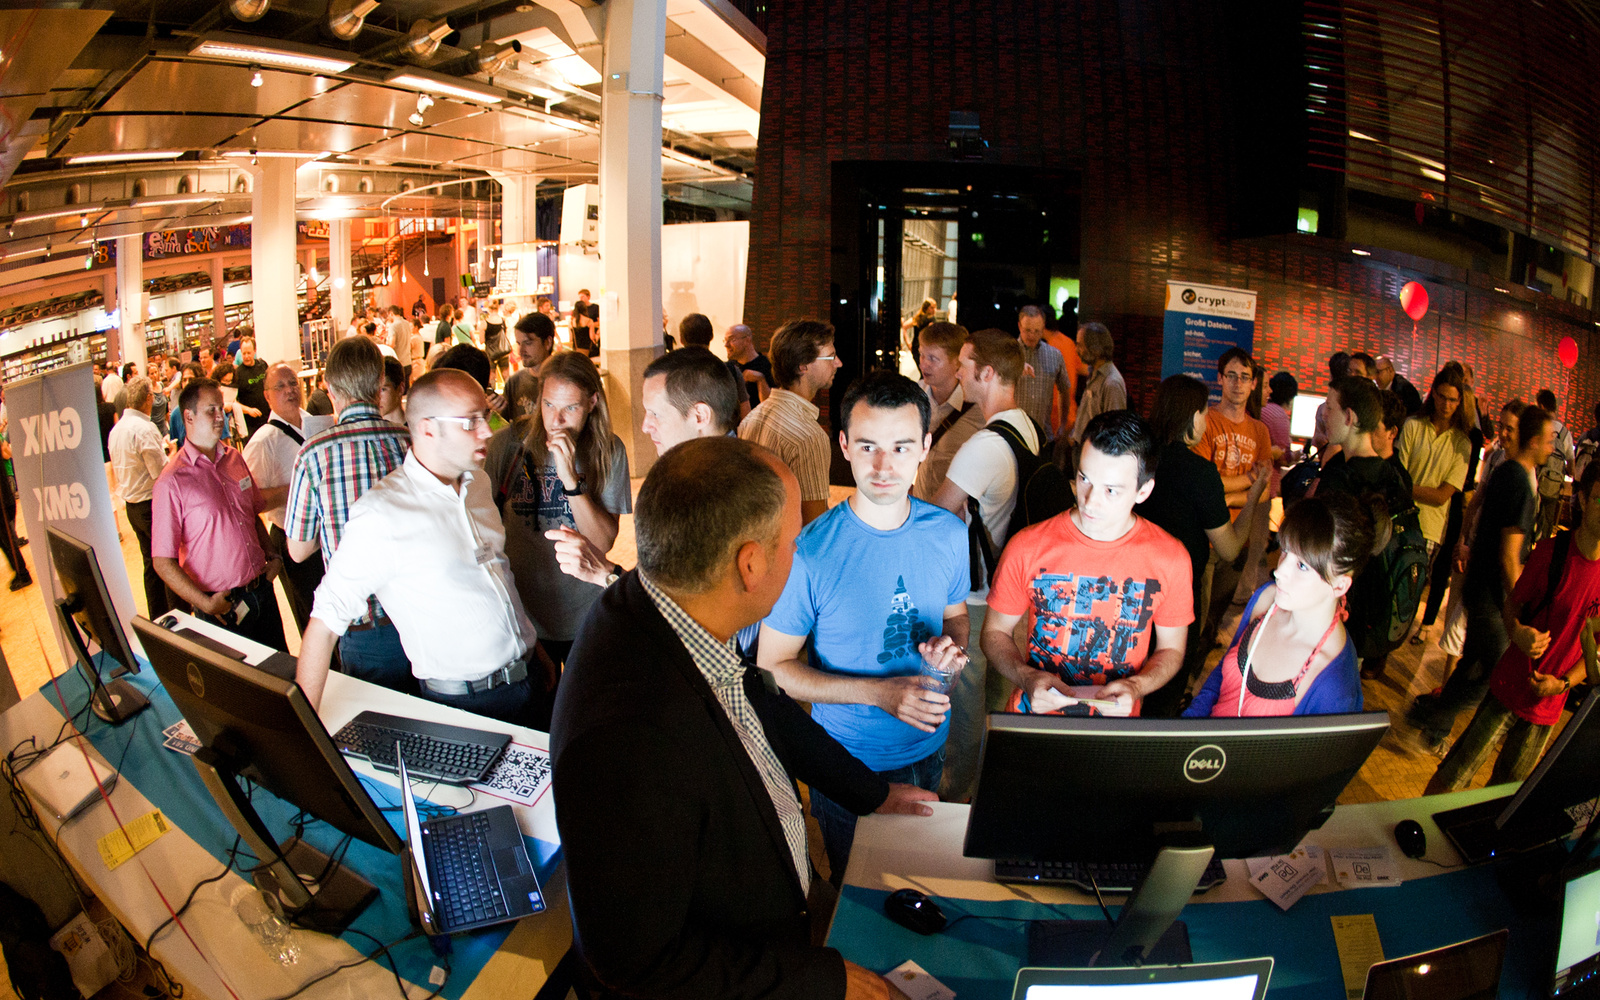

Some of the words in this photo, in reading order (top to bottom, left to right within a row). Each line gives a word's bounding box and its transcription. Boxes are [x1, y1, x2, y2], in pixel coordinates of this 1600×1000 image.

[1184, 317, 1206, 328] Große
[1230, 431, 1256, 450] TAILOR
[1240, 453, 1254, 464] 62
[1188, 758, 1221, 771] DELL
[1356, 864, 1369, 874] De
